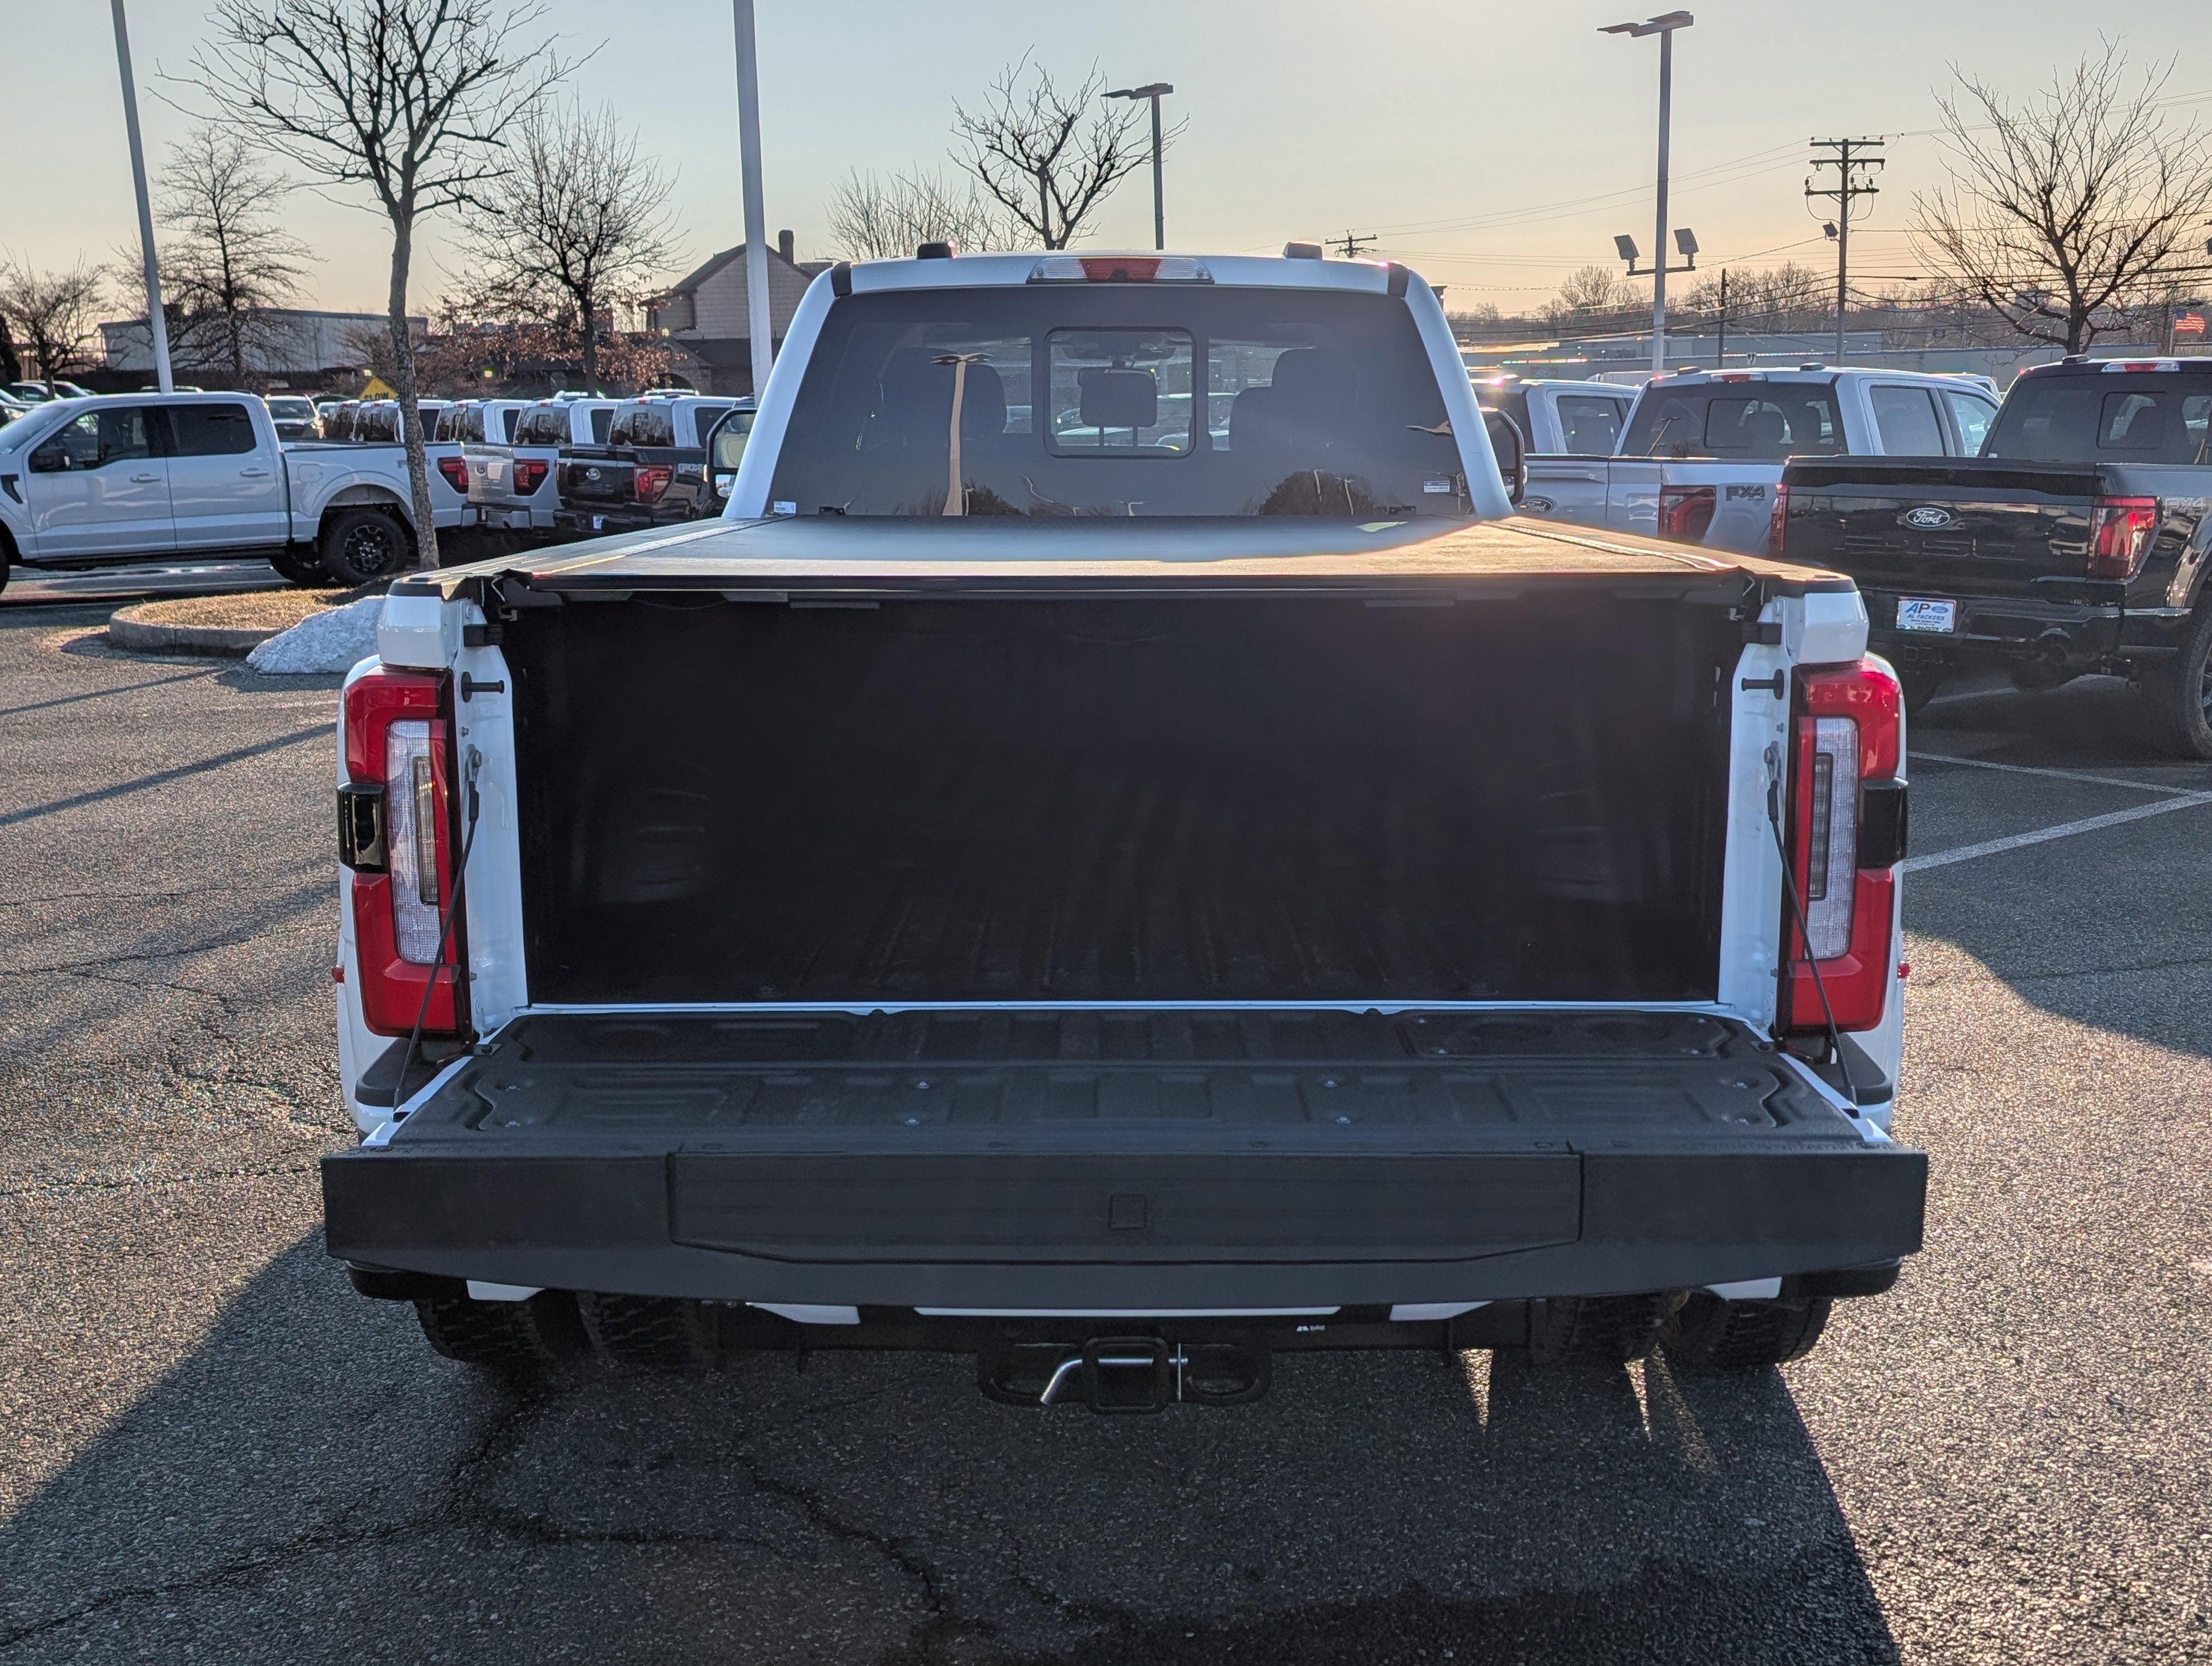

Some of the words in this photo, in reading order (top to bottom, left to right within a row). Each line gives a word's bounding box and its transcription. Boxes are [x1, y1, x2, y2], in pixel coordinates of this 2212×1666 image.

[1726, 485, 1765, 501] FX4
[2164, 497, 2206, 516] FX4
[1913, 510, 1943, 524] Ford
[1905, 603, 1931, 614] AP
